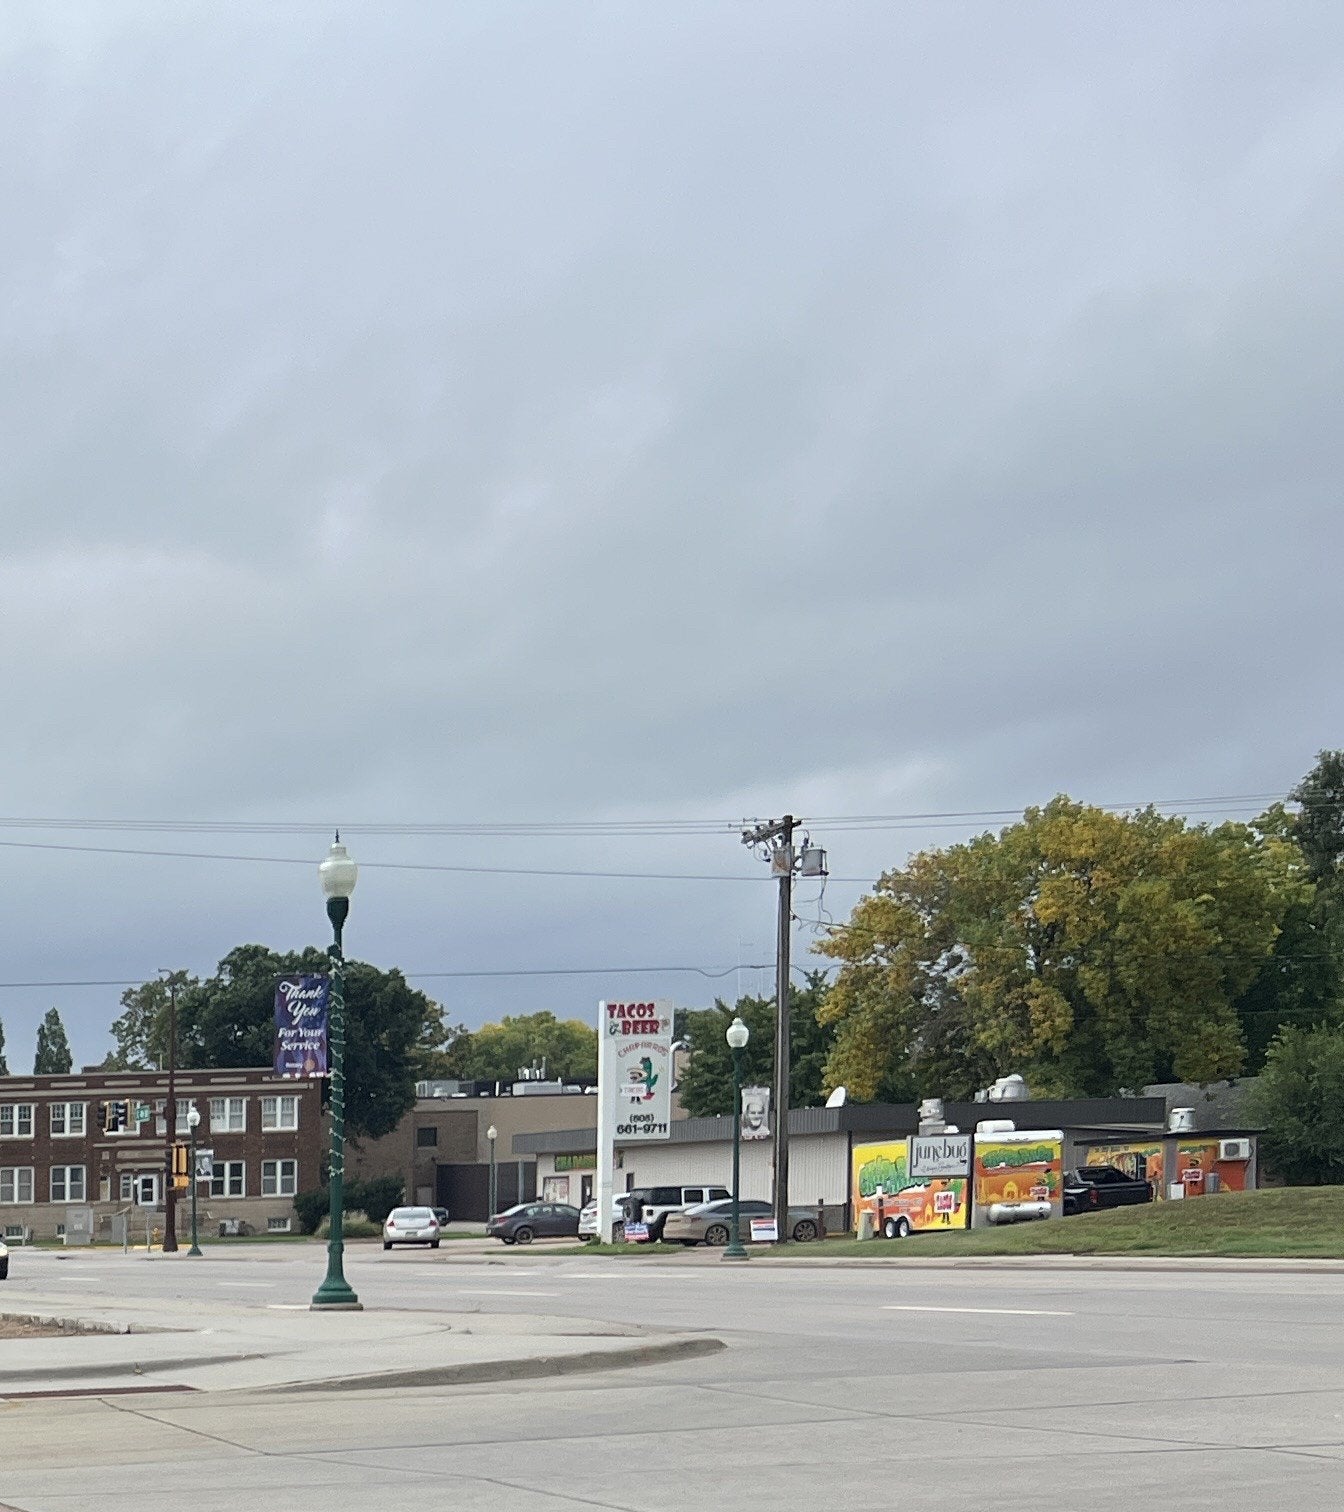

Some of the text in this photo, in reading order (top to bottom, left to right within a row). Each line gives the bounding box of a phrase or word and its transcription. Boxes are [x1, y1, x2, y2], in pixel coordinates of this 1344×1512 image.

[279, 981, 324, 1001] Thank
[287, 1000, 321, 1025] You
[607, 1003, 655, 1018] TACOS
[278, 1027, 323, 1038] For Your
[622, 1020, 660, 1035] BEER
[281, 1041, 320, 1051] Service
